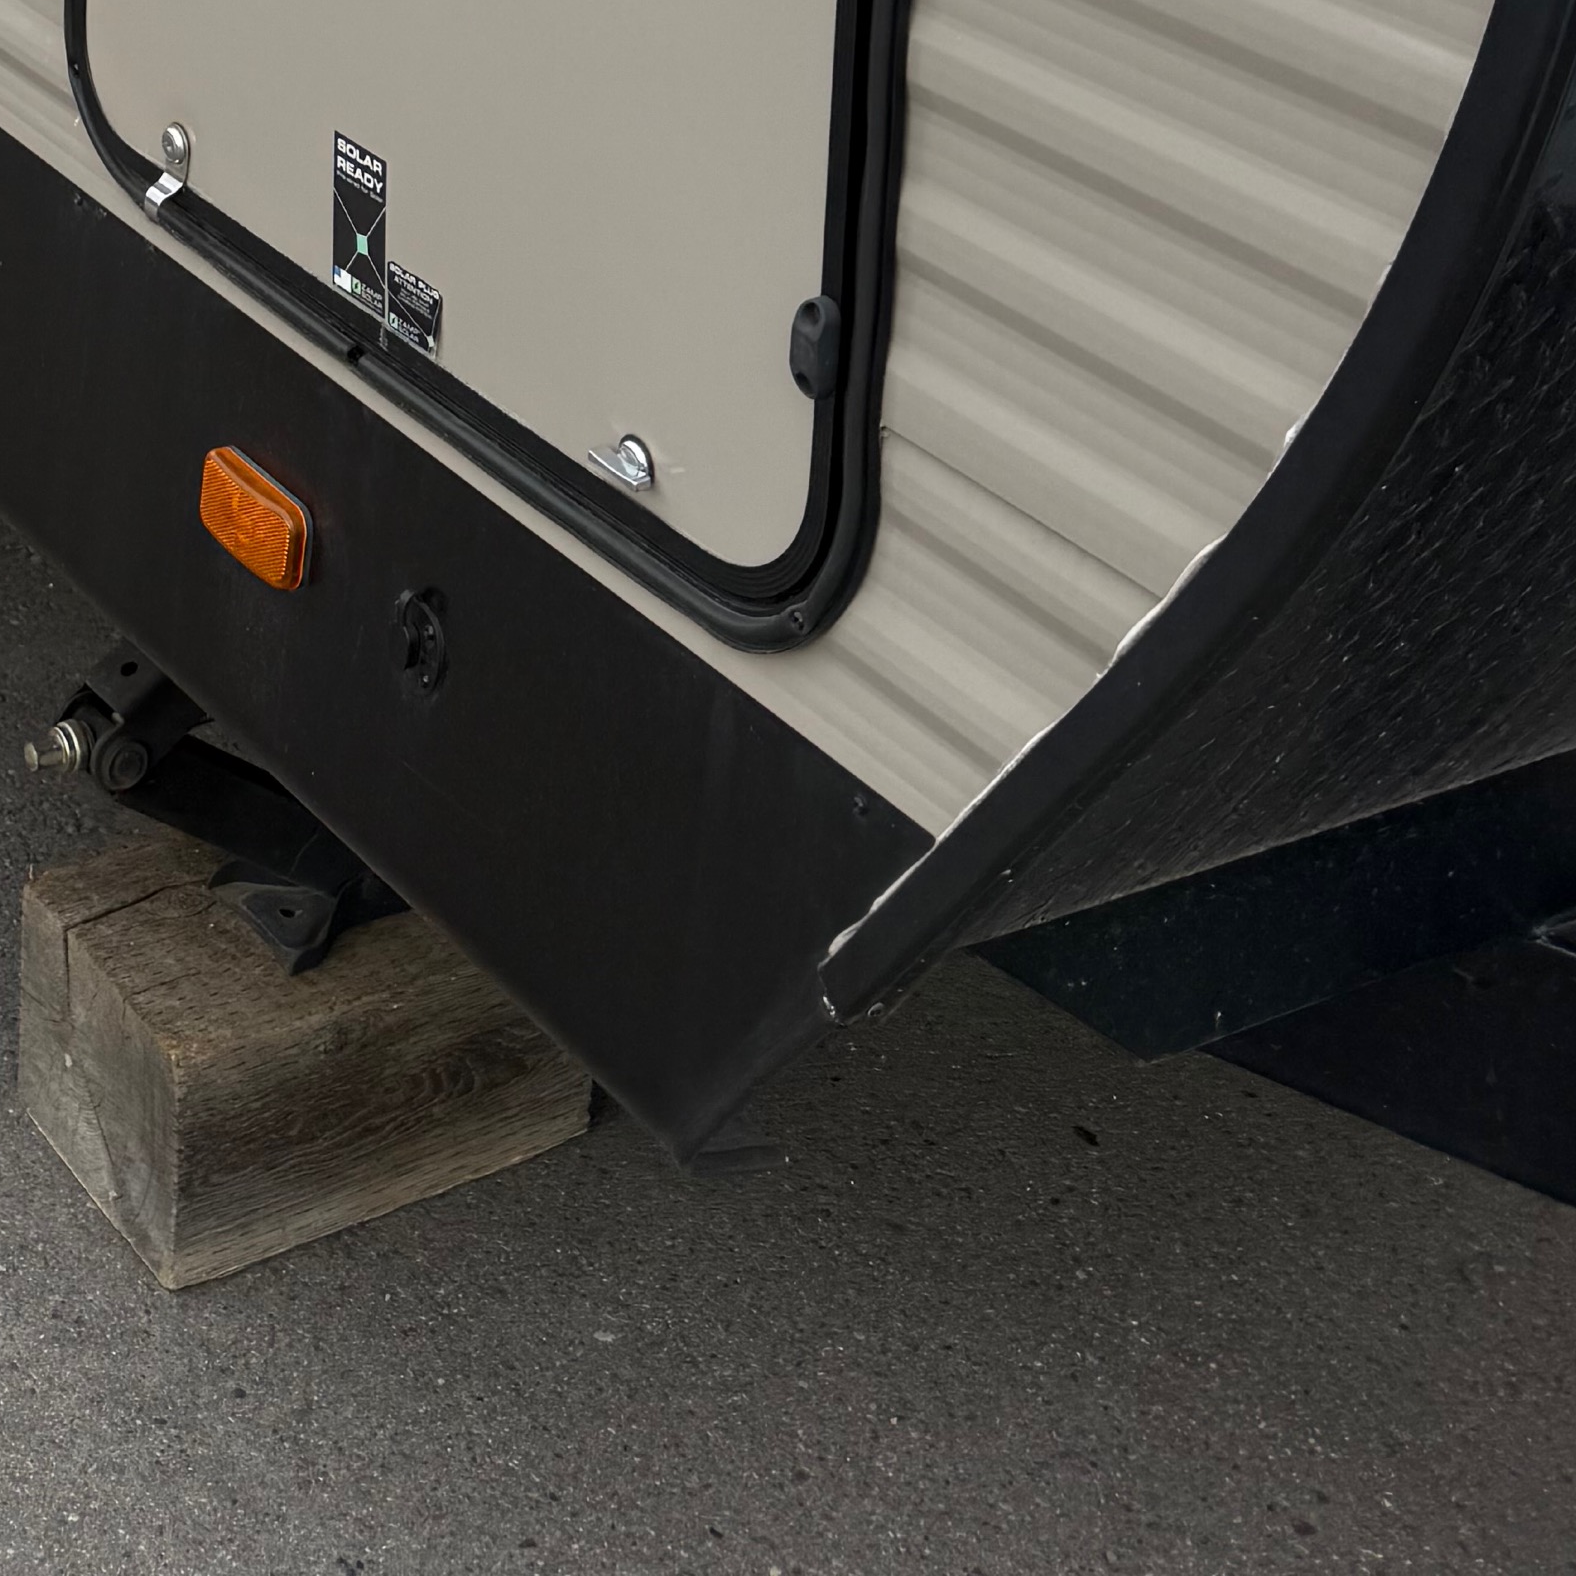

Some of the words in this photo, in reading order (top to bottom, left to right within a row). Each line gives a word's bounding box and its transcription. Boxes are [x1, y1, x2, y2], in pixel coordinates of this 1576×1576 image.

[336, 155, 384, 194] READY
[337, 137, 383, 177] SOLAR
[389, 262, 416, 286] SOLAR
[417, 280, 440, 301] PLUG
[394, 275, 434, 305] ATTENTION
